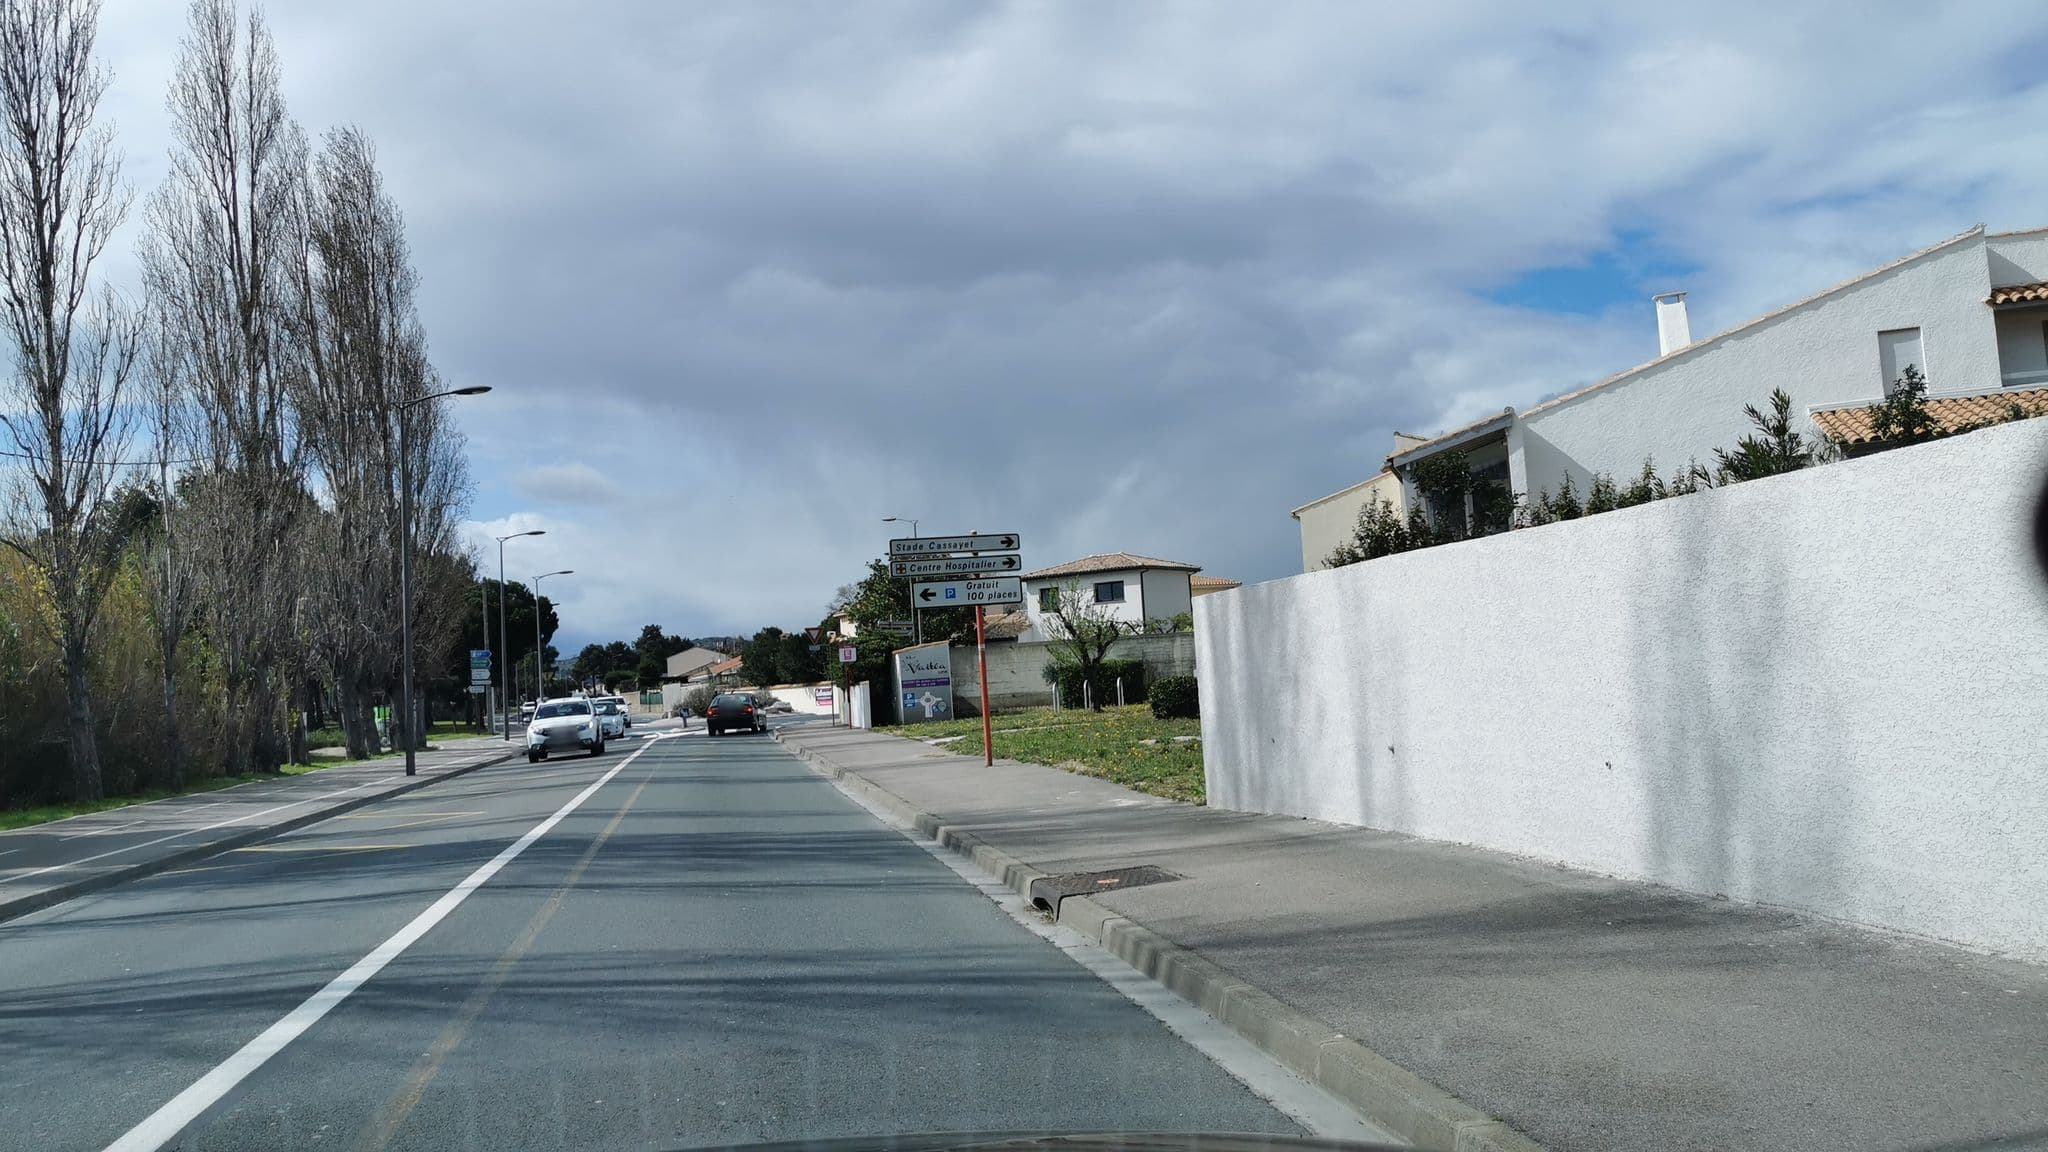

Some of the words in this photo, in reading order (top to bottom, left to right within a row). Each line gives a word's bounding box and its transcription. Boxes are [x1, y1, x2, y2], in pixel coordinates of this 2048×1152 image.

[895, 543, 924, 552] Stade
[928, 540, 974, 551] Cassayet
[909, 563, 942, 573] Centre
[945, 561, 997, 572] Hospitalier
[966, 581, 999, 590] Gratuit
[967, 591, 985, 601] 100
[988, 591, 1018, 601] places
